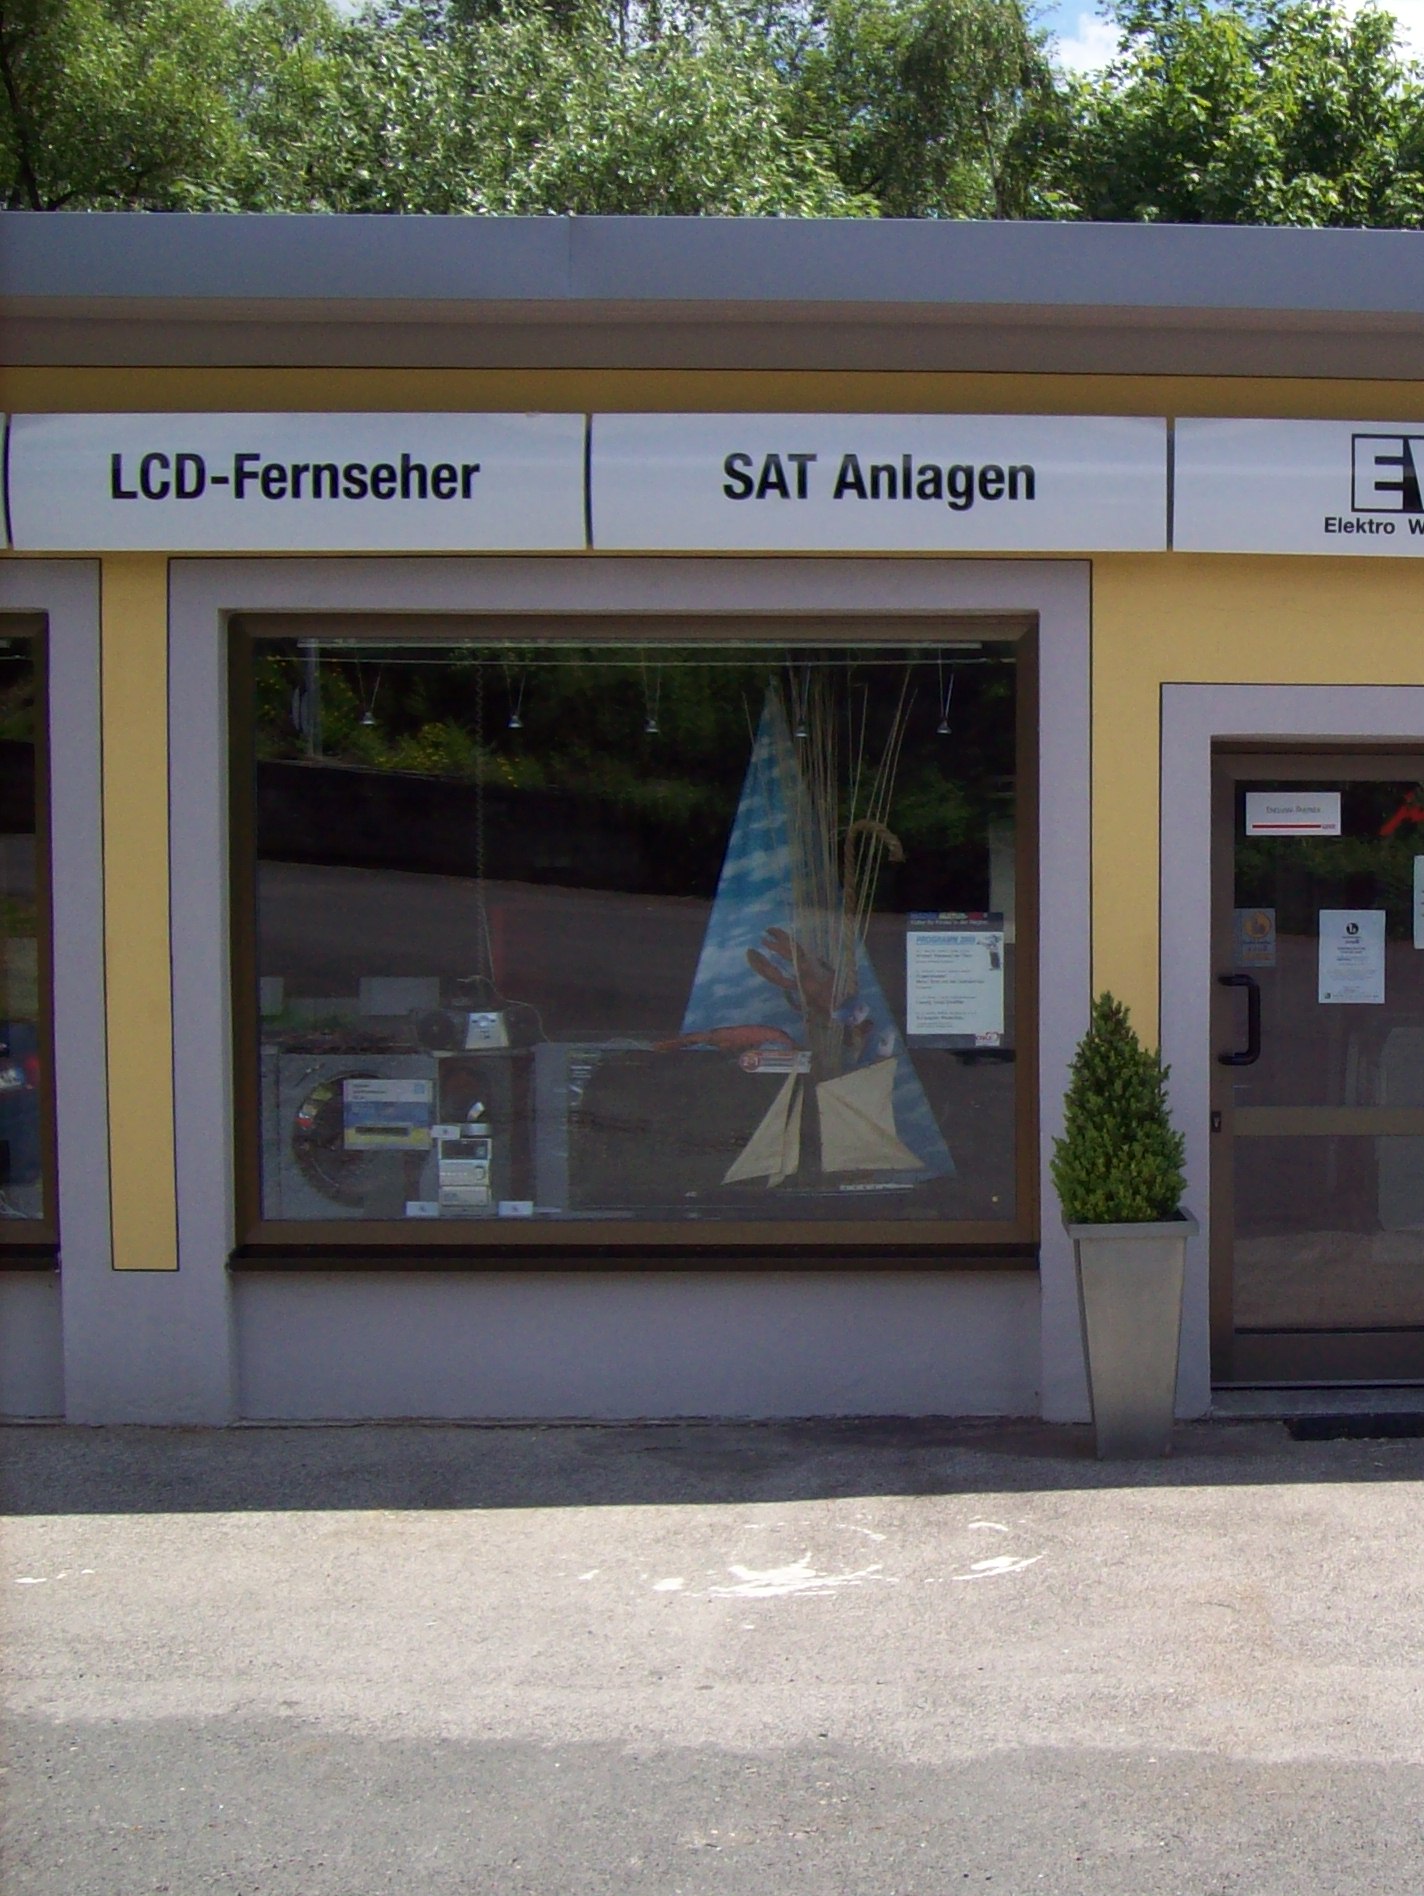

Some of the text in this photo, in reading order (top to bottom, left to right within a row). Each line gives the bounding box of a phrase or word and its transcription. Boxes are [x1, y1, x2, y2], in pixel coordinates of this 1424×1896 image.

[110, 452, 481, 500] LCD-Fernseher
[722, 452, 1037, 511] SAT Anlagen
[1323, 516, 1396, 535] Elektro
